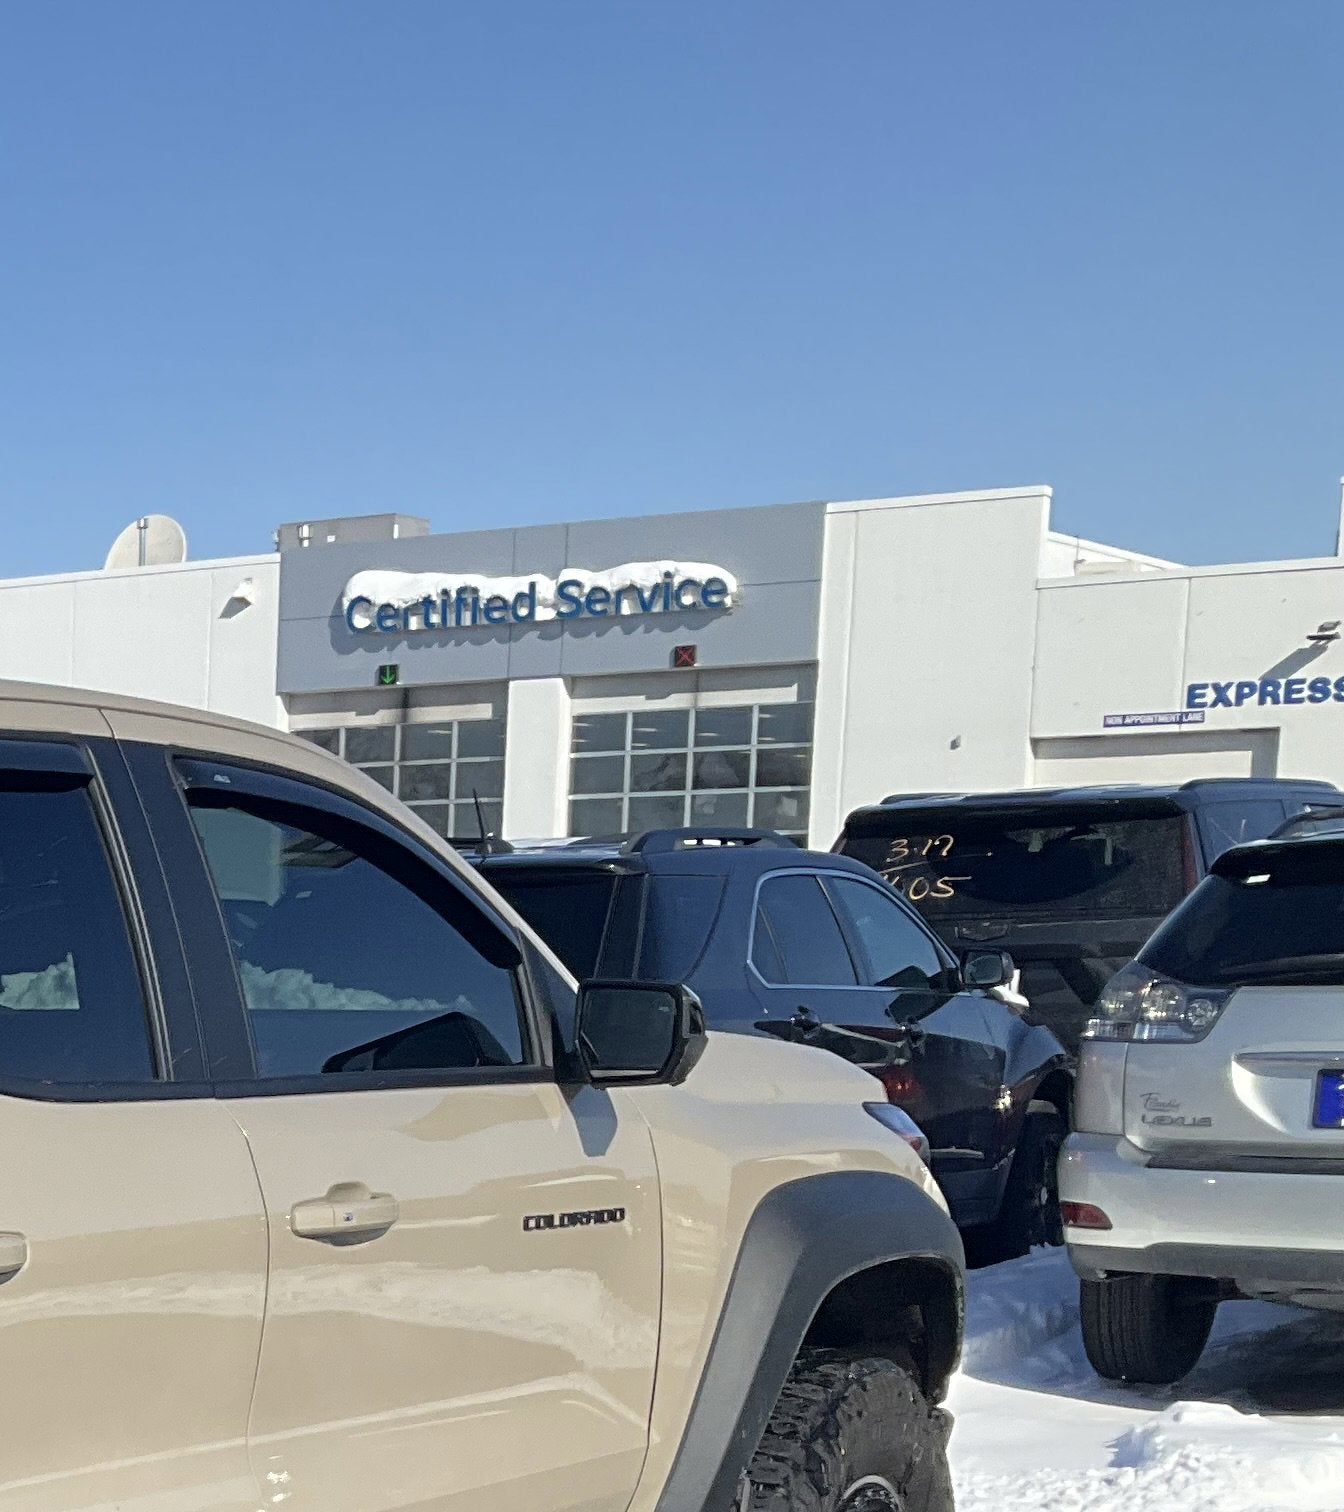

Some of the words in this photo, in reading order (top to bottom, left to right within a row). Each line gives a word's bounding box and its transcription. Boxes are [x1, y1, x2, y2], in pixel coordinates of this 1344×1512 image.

[346, 582, 536, 634] Certified
[556, 571, 730, 619] Service
[1105, 714, 1124, 726] NON
[1125, 712, 1179, 725] APPOINTMENT
[1182, 711, 1204, 722] LANE
[523, 1207, 625, 1232] COLORADO
